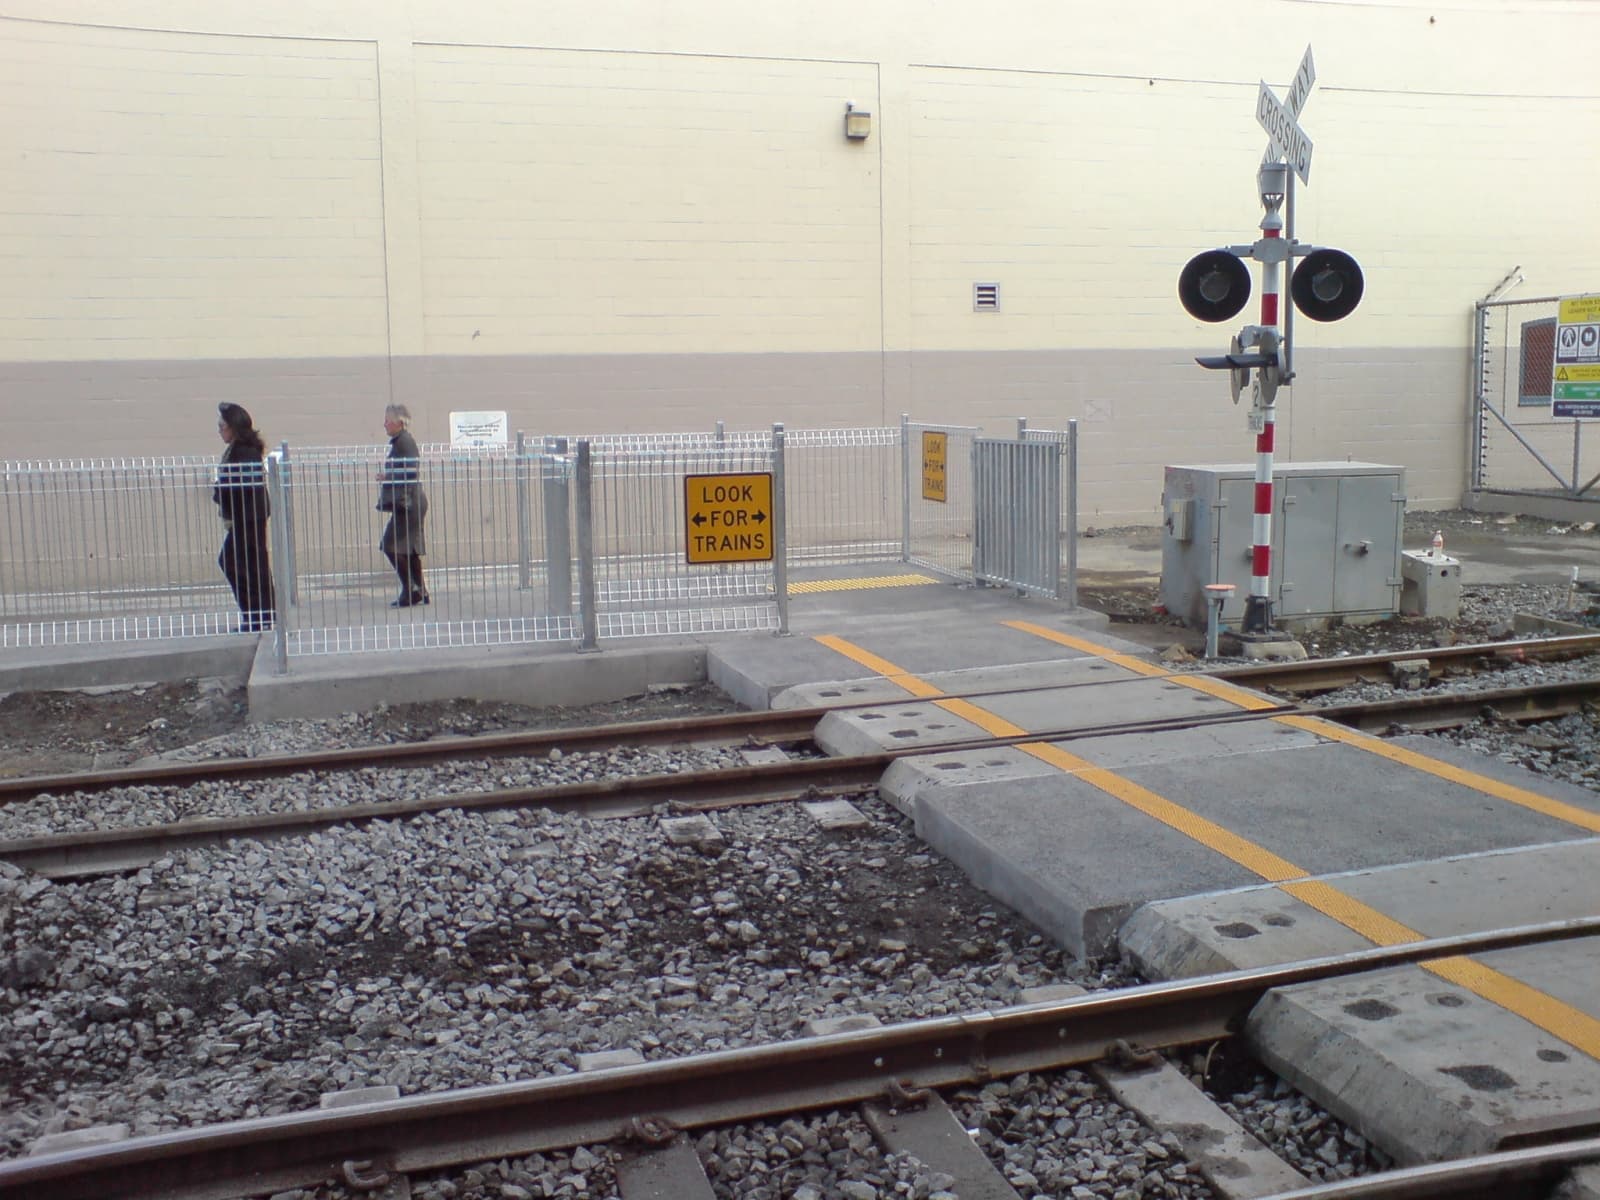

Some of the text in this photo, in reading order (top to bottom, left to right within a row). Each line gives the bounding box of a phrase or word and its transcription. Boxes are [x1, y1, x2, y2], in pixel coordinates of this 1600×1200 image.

[1289, 56, 1310, 115] WAY
[1260, 91, 1306, 172] CROSSING
[703, 485, 753, 503] LOOK
[711, 509, 748, 527] FOR
[694, 533, 765, 552] TRAINS
